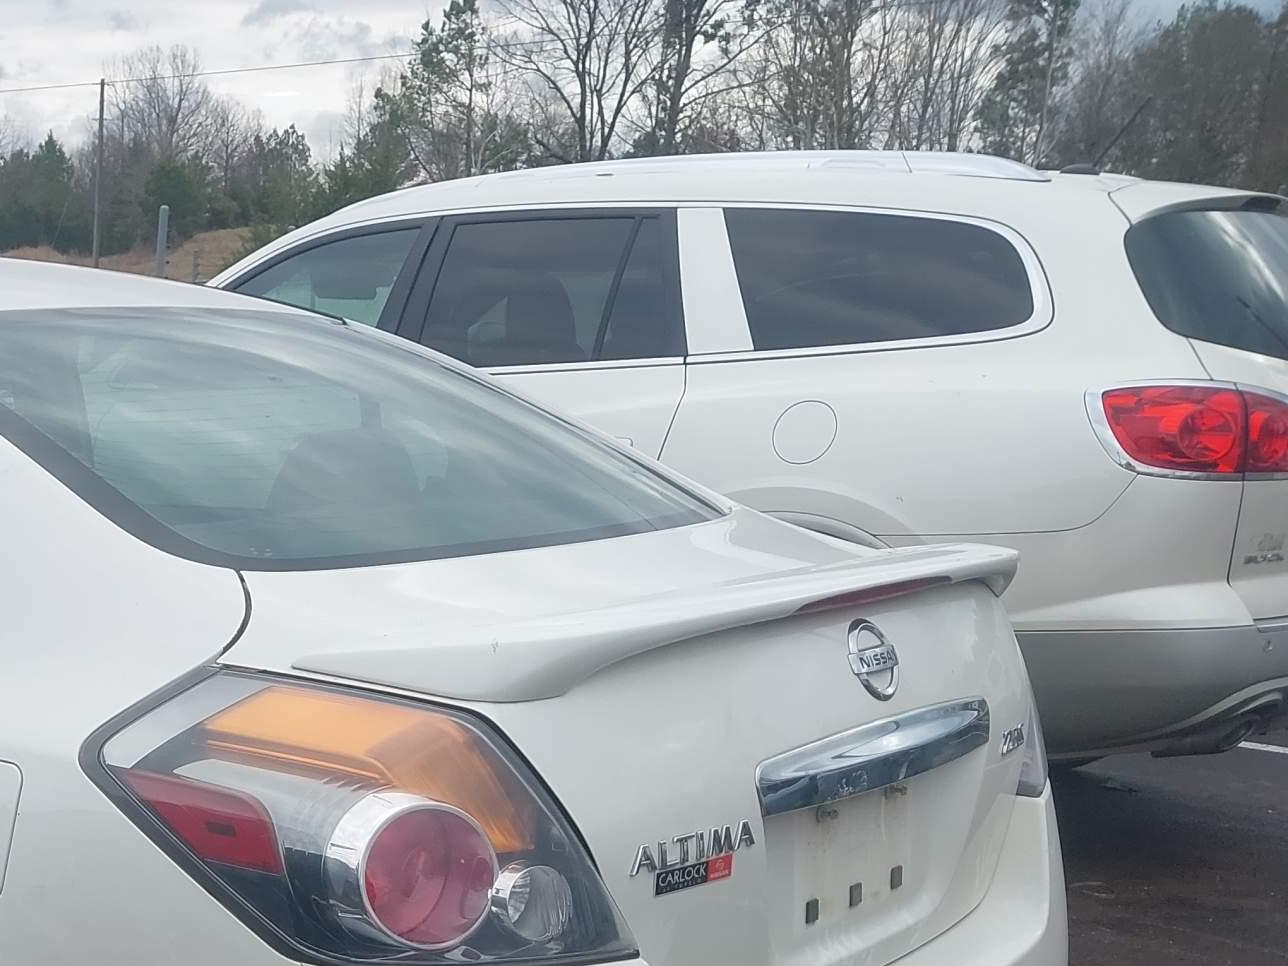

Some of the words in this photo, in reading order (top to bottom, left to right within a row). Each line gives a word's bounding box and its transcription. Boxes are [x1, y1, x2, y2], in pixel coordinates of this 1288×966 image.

[858, 649, 896, 669] NISSA
[629, 818, 756, 877] ALTIMA
[658, 863, 707, 887] CARLOCK
